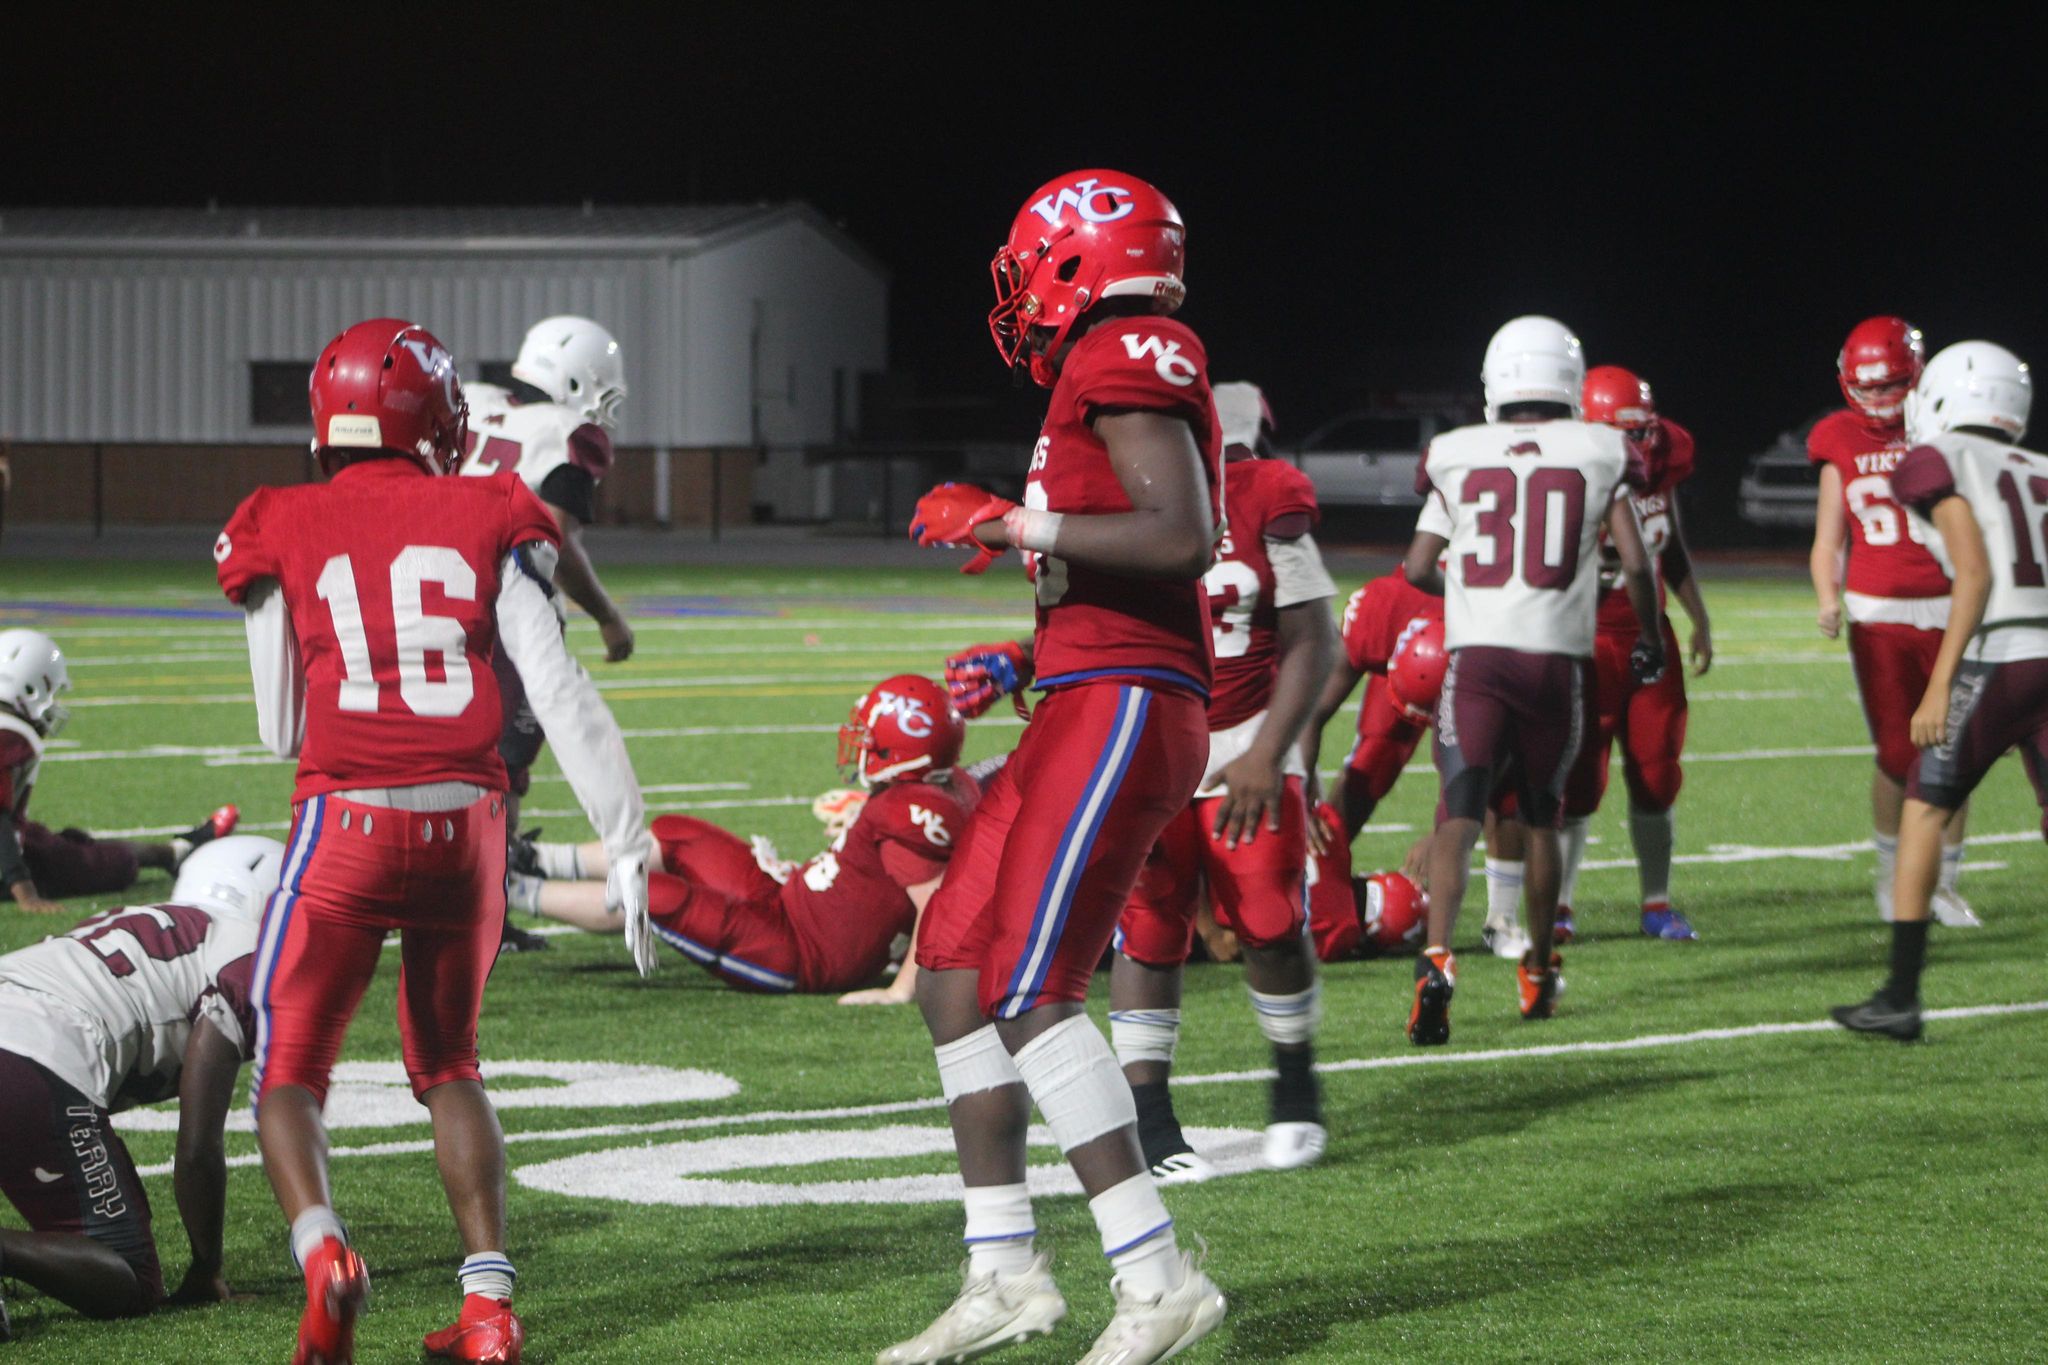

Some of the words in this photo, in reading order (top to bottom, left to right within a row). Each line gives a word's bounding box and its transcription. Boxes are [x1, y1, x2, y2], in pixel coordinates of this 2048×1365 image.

[1030, 178, 1134, 223] WC
[1120, 334, 1197, 387] WC
[1461, 467, 1586, 590] 30
[1846, 475, 1926, 545] 6
[316, 545, 477, 718] 16
[909, 803, 951, 848] WC
